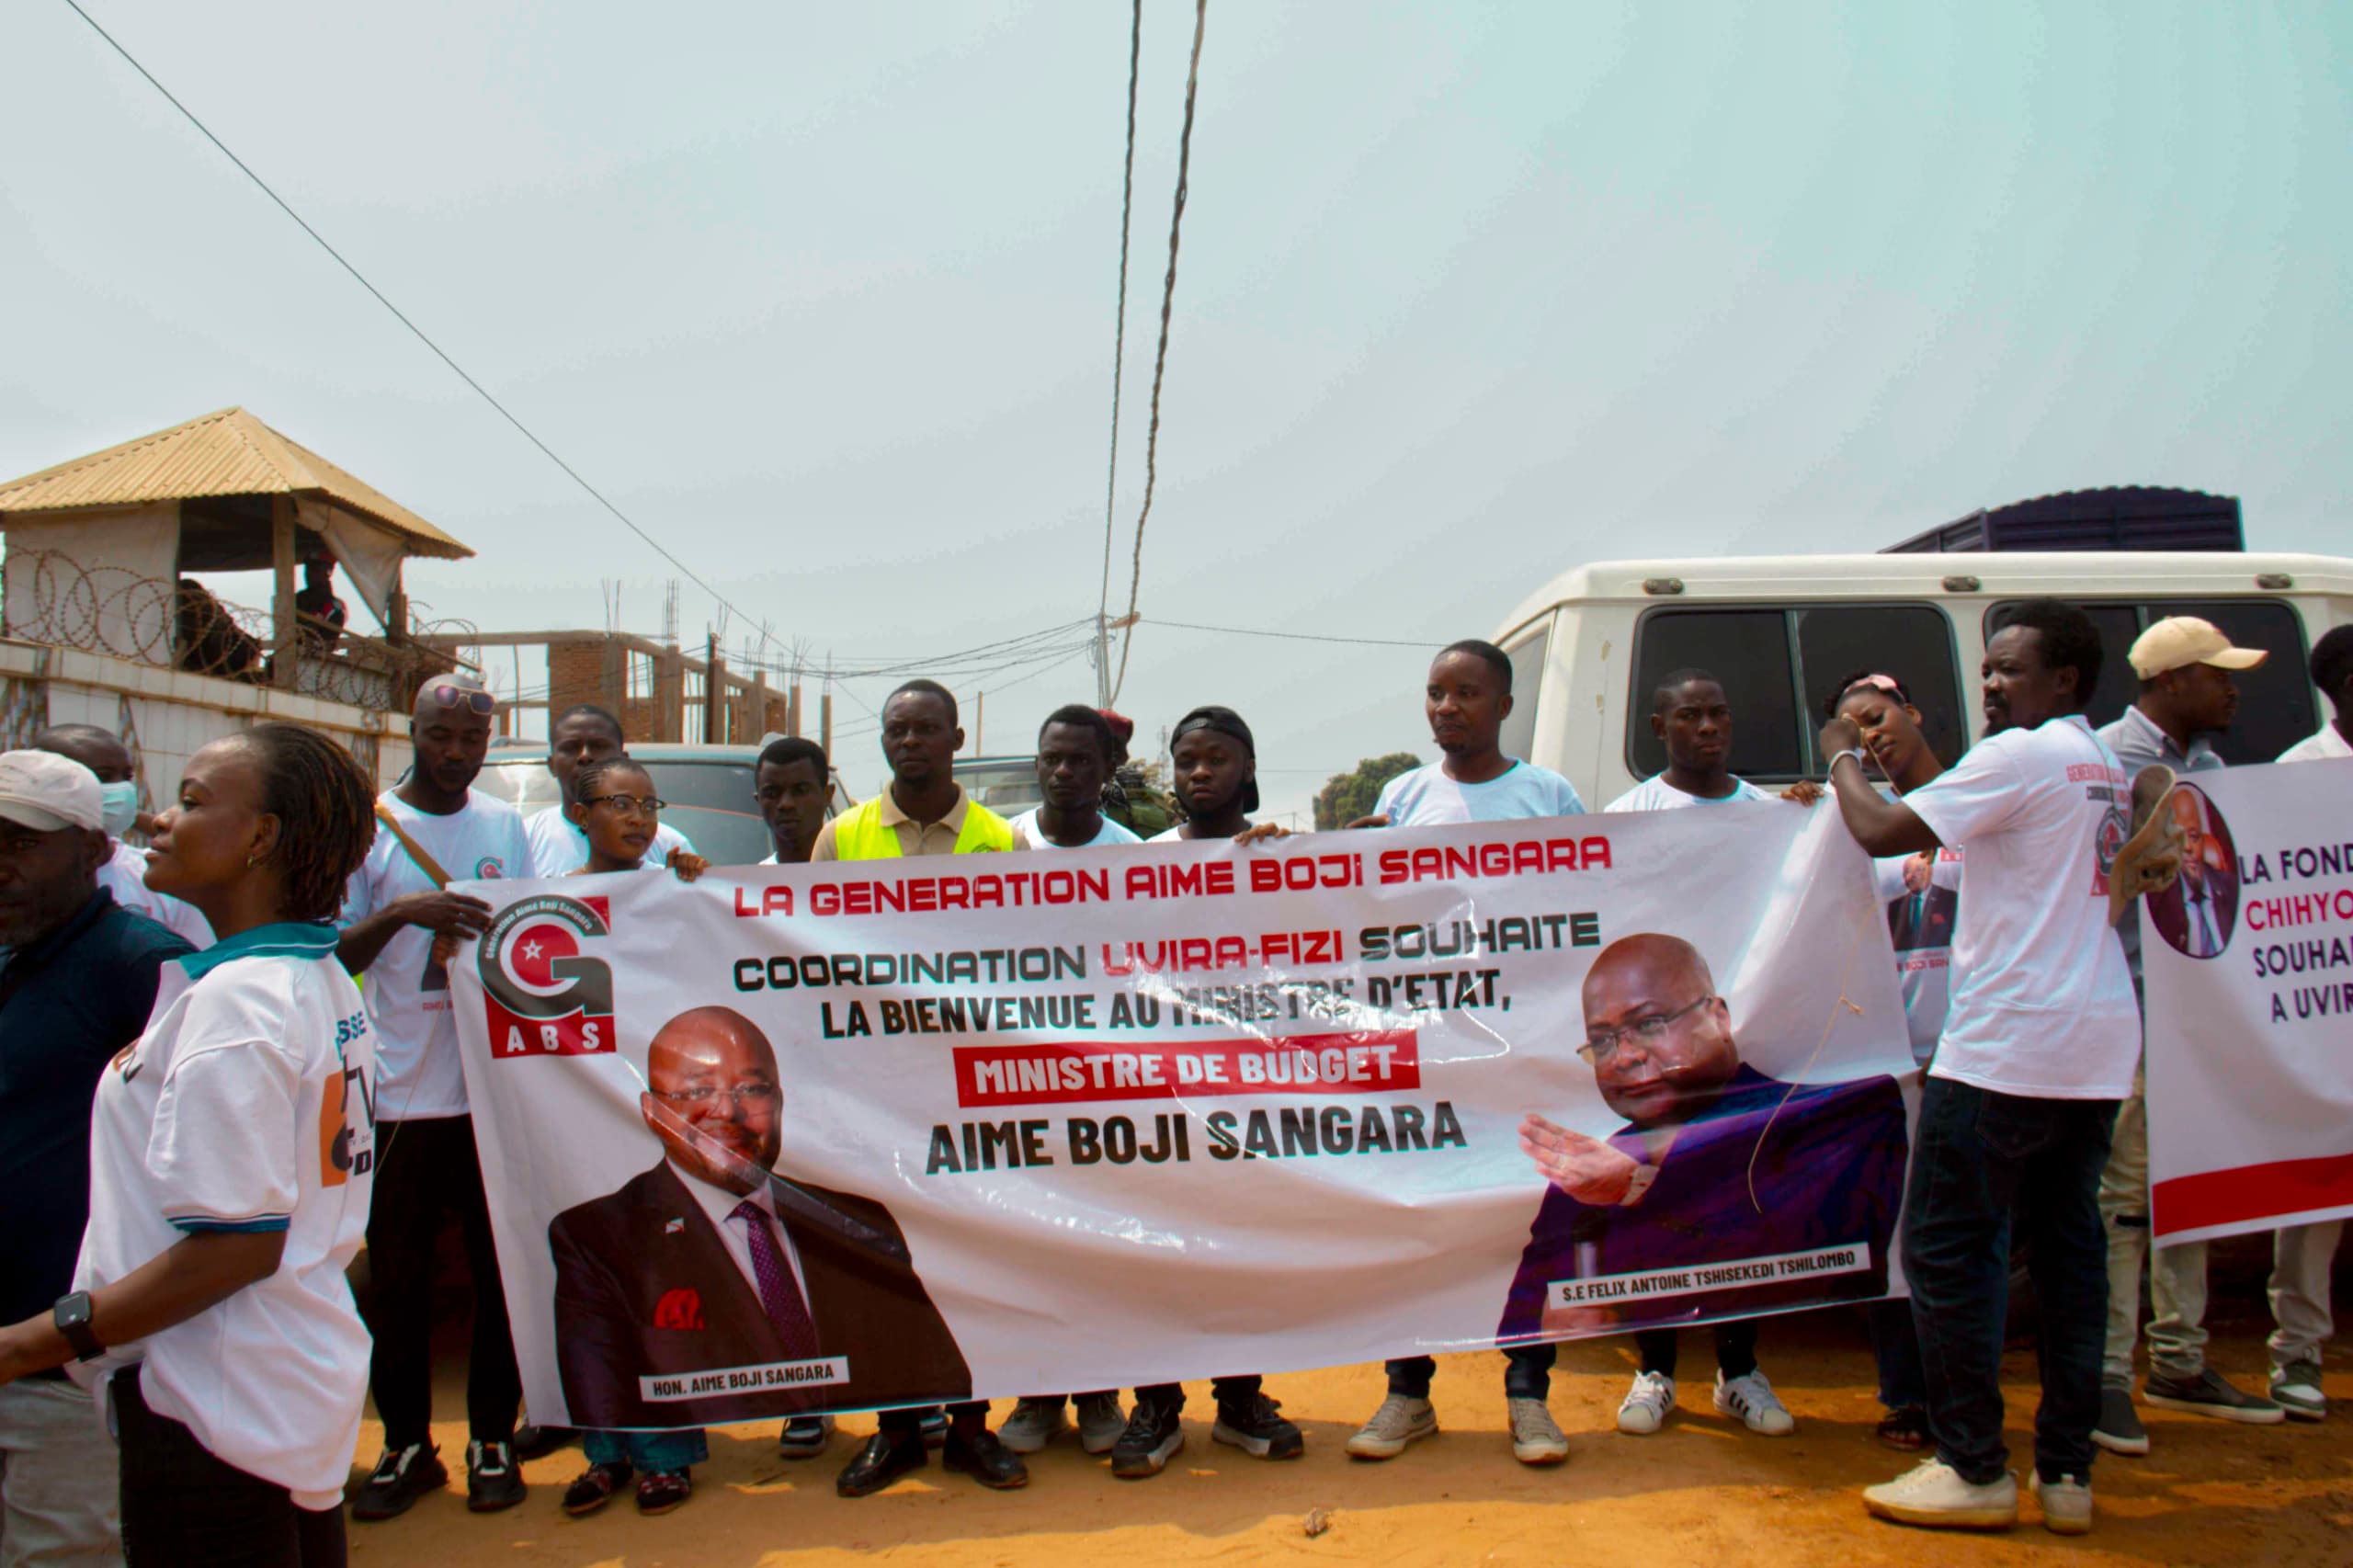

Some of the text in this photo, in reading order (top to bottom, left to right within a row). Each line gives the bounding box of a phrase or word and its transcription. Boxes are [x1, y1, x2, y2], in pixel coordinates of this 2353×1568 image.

[734, 835, 1613, 917] LA GENERATION AIME BOJI SANGARA
[2238, 853, 2272, 885] LA
[2245, 890, 2353, 931] CHIHYO
[733, 912, 1600, 992] COORDINATION UVIRA-FIZI SOUHAITE
[822, 1001, 872, 1040] LA
[881, 994, 1097, 1035] BIENVENUE
[1109, 991, 1160, 1028] AU
[2271, 993, 2289, 1023] A
[973, 1045, 1398, 1094] MINISTRE DE BUDGET
[926, 1100, 1467, 1176] AIME BOJI SANGARA
[1563, 1250, 1856, 1302] S.E FELIX ANTOINE TSHISEKEDI TSHILOMBO
[653, 1363, 835, 1397] HON. AIME BOJI SANGARA
